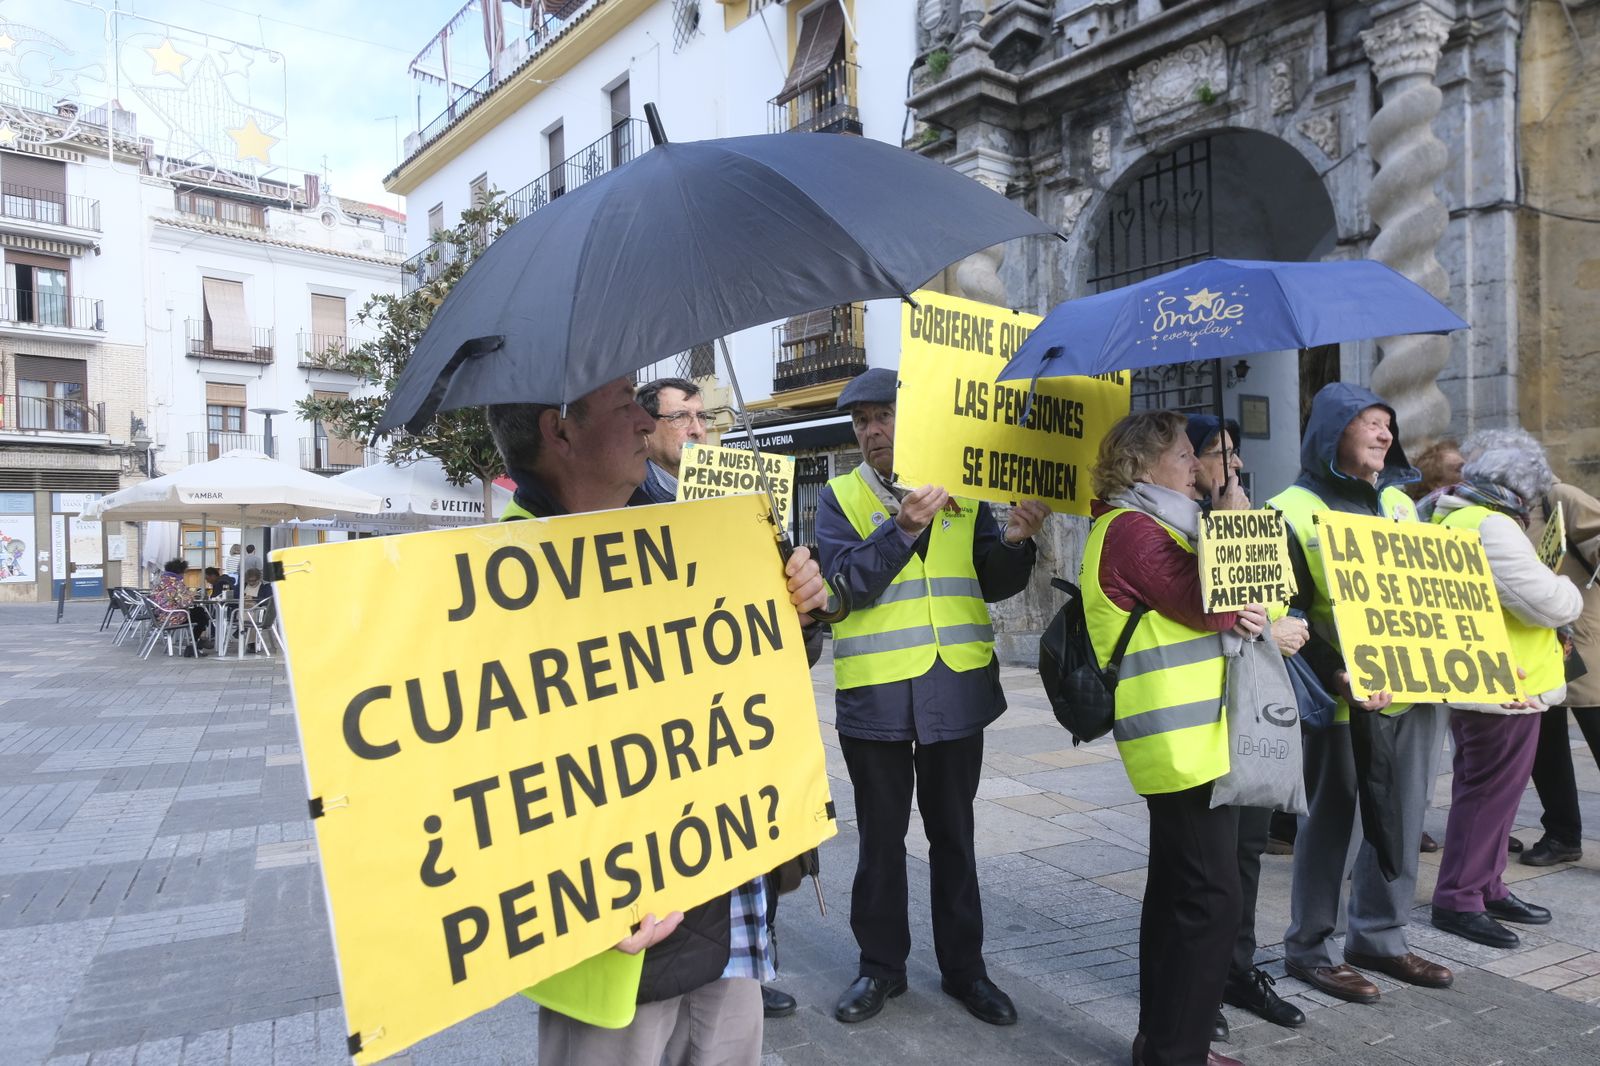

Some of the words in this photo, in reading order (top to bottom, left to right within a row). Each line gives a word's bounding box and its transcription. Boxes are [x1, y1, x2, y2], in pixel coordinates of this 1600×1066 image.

[910, 304, 994, 356] GOBIERNE
[1153, 296, 1244, 332] Smile
[1162, 321, 1232, 342] everyday
[954, 378, 988, 421] LAS
[993, 385, 1083, 439] PENSIONES
[762, 437, 771, 447] LA
[772, 434, 793, 445] VENIA
[684, 466, 789, 494] PENSIONES
[697, 449, 713, 465] DE
[719, 451, 781, 474] NUESTRAS
[962, 446, 984, 487] SE
[988, 450, 1077, 502] DEFIENDEN
[1205, 515, 1282, 539] PENSIONES
[1216, 545, 1241, 564] COMO
[1246, 544, 1278, 562] SIEMPRE
[1326, 524, 1364, 564] LA
[1371, 530, 1484, 576] PENSIÓN
[448, 525, 697, 622] JOVEN,
[1212, 567, 1223, 586] EL
[1228, 564, 1282, 584] GOBIERNO
[1335, 568, 1370, 602] NO
[1376, 572, 1403, 605] SE
[1407, 575, 1494, 613] DEFIENDE
[1209, 584, 1285, 607] MIENTE
[1365, 607, 1448, 640] DESDE
[1455, 614, 1485, 642] EL
[343, 597, 784, 760] CUARENTÓN
[1354, 644, 1516, 695] SILLÓN
[420, 692, 775, 887] ¿TENDRÁS
[442, 784, 780, 985] PENSIÓN?
